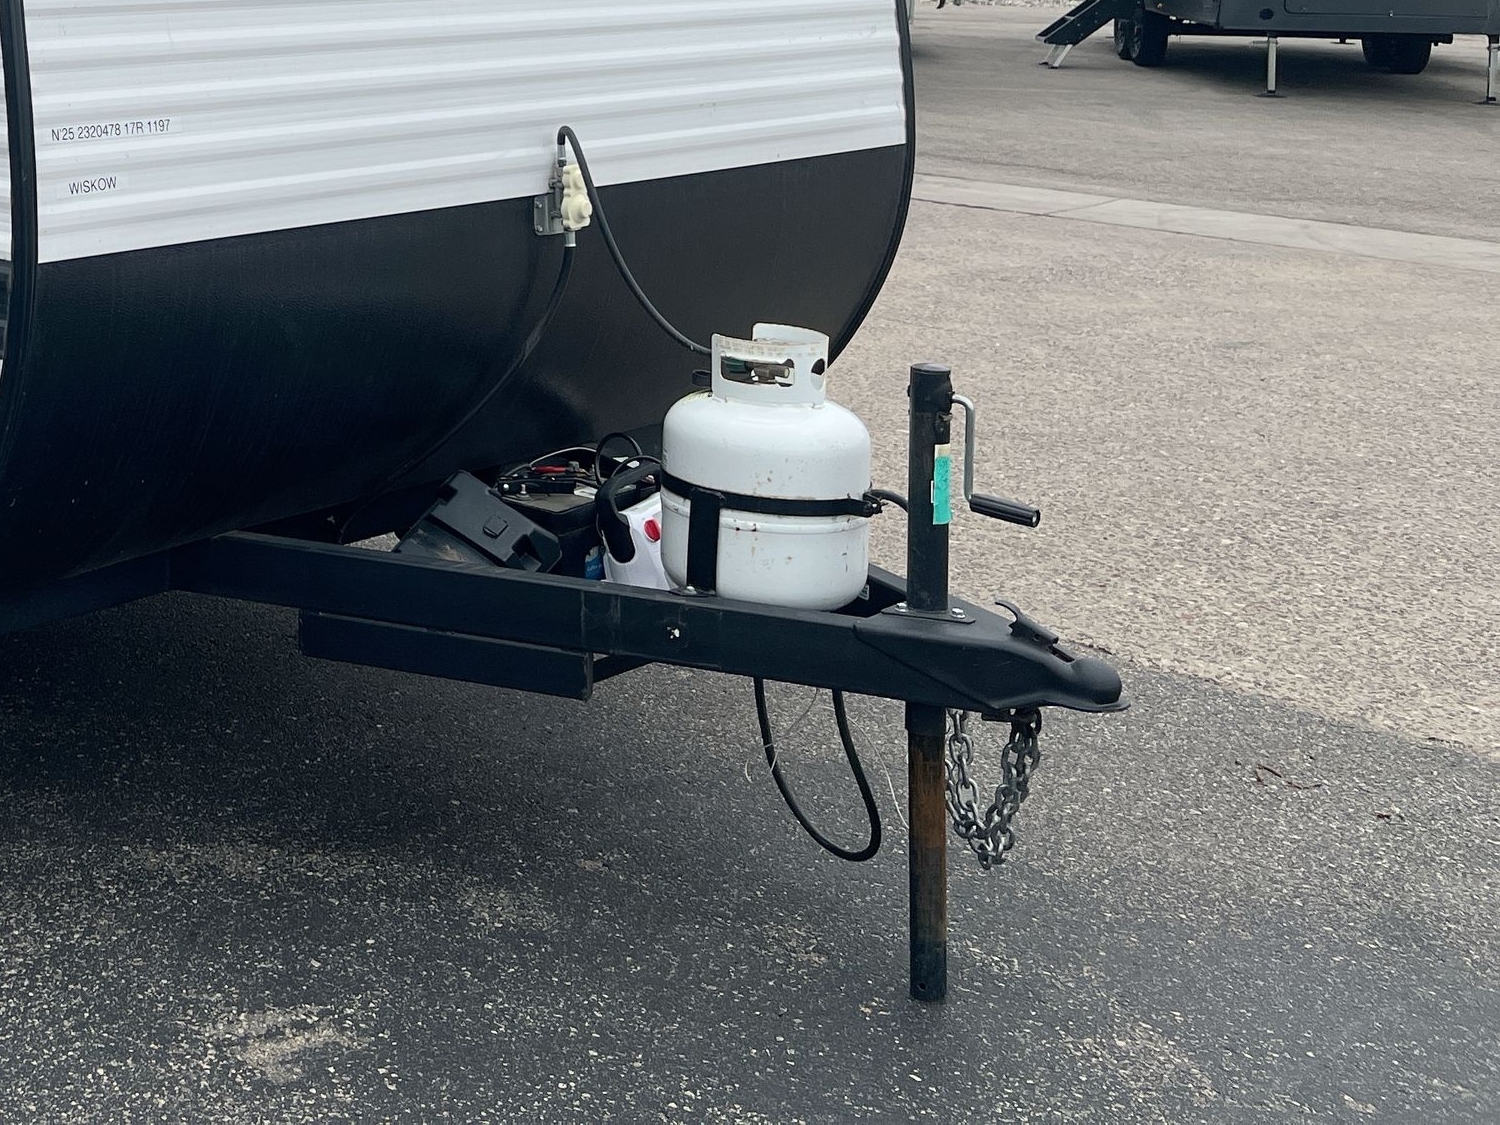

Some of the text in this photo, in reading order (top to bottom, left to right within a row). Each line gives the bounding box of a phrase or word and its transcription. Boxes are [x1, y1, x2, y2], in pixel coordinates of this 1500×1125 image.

[77, 122, 122, 139] 2320478
[124, 121, 145, 135] 17R
[147, 118, 171, 134] 1197
[68, 176, 118, 195] WISKOW
